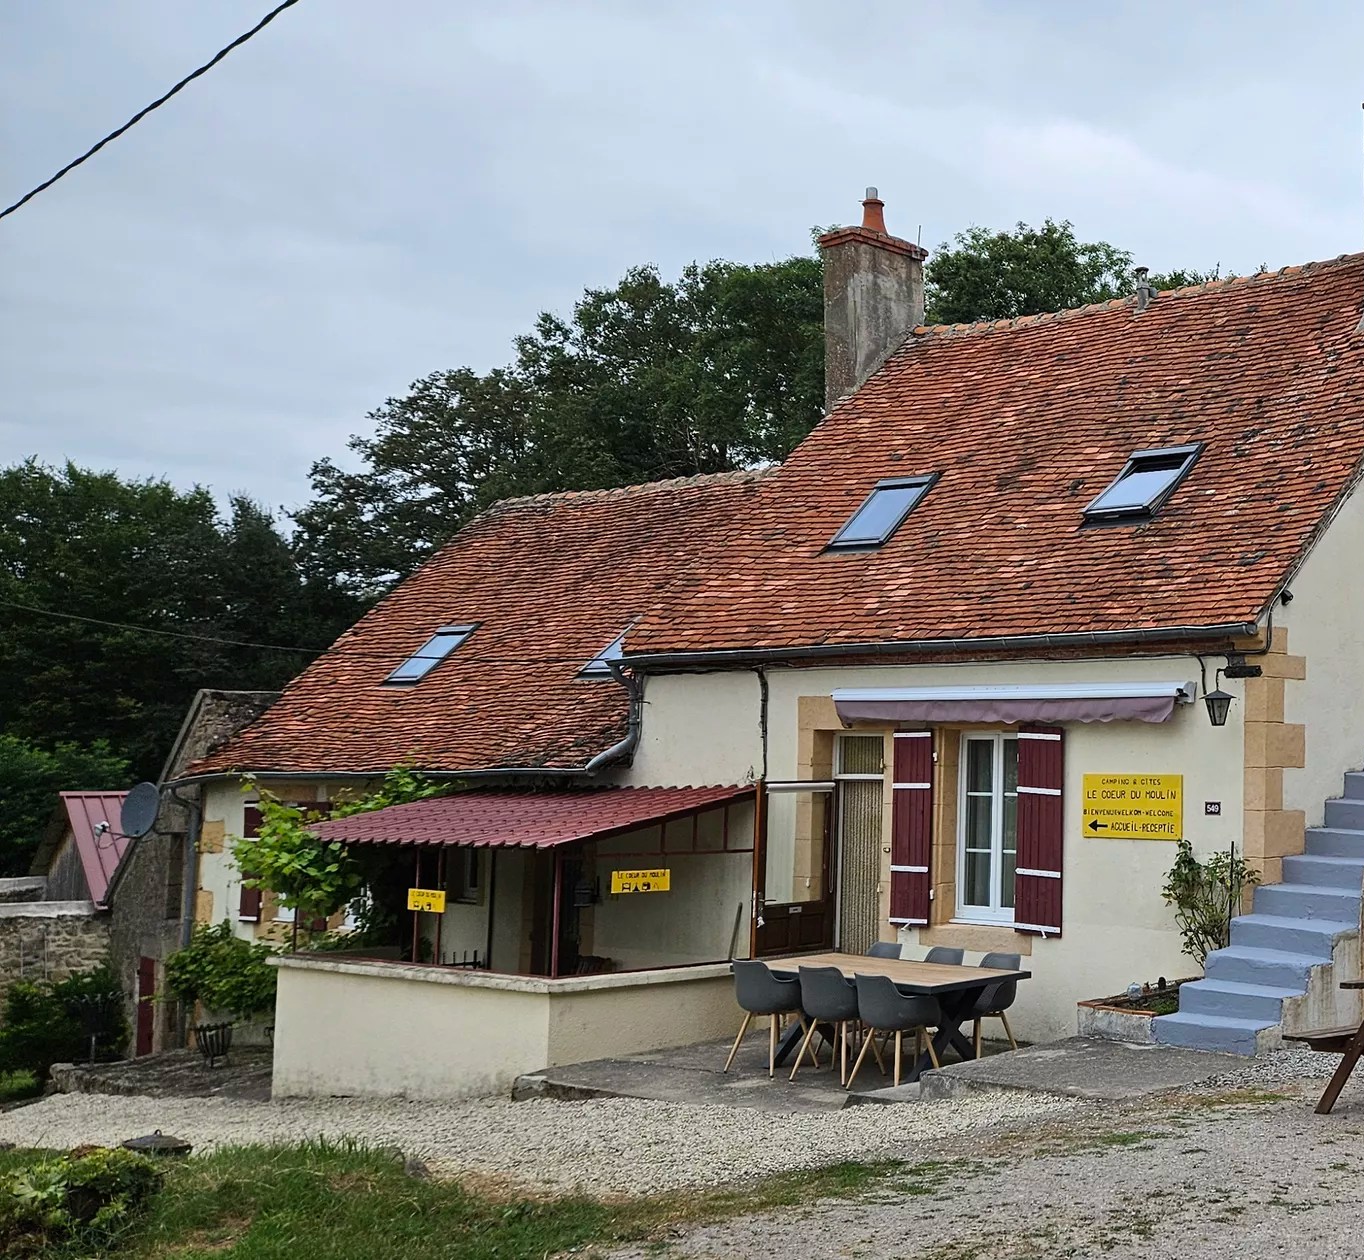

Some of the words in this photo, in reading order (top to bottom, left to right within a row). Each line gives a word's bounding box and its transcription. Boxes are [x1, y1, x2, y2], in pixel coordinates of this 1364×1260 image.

[1087, 790, 1097, 799] LE
[1101, 790, 1126, 799] COEUR
[1130, 790, 1141, 799] DU
[1207, 804, 1219, 813] 549
